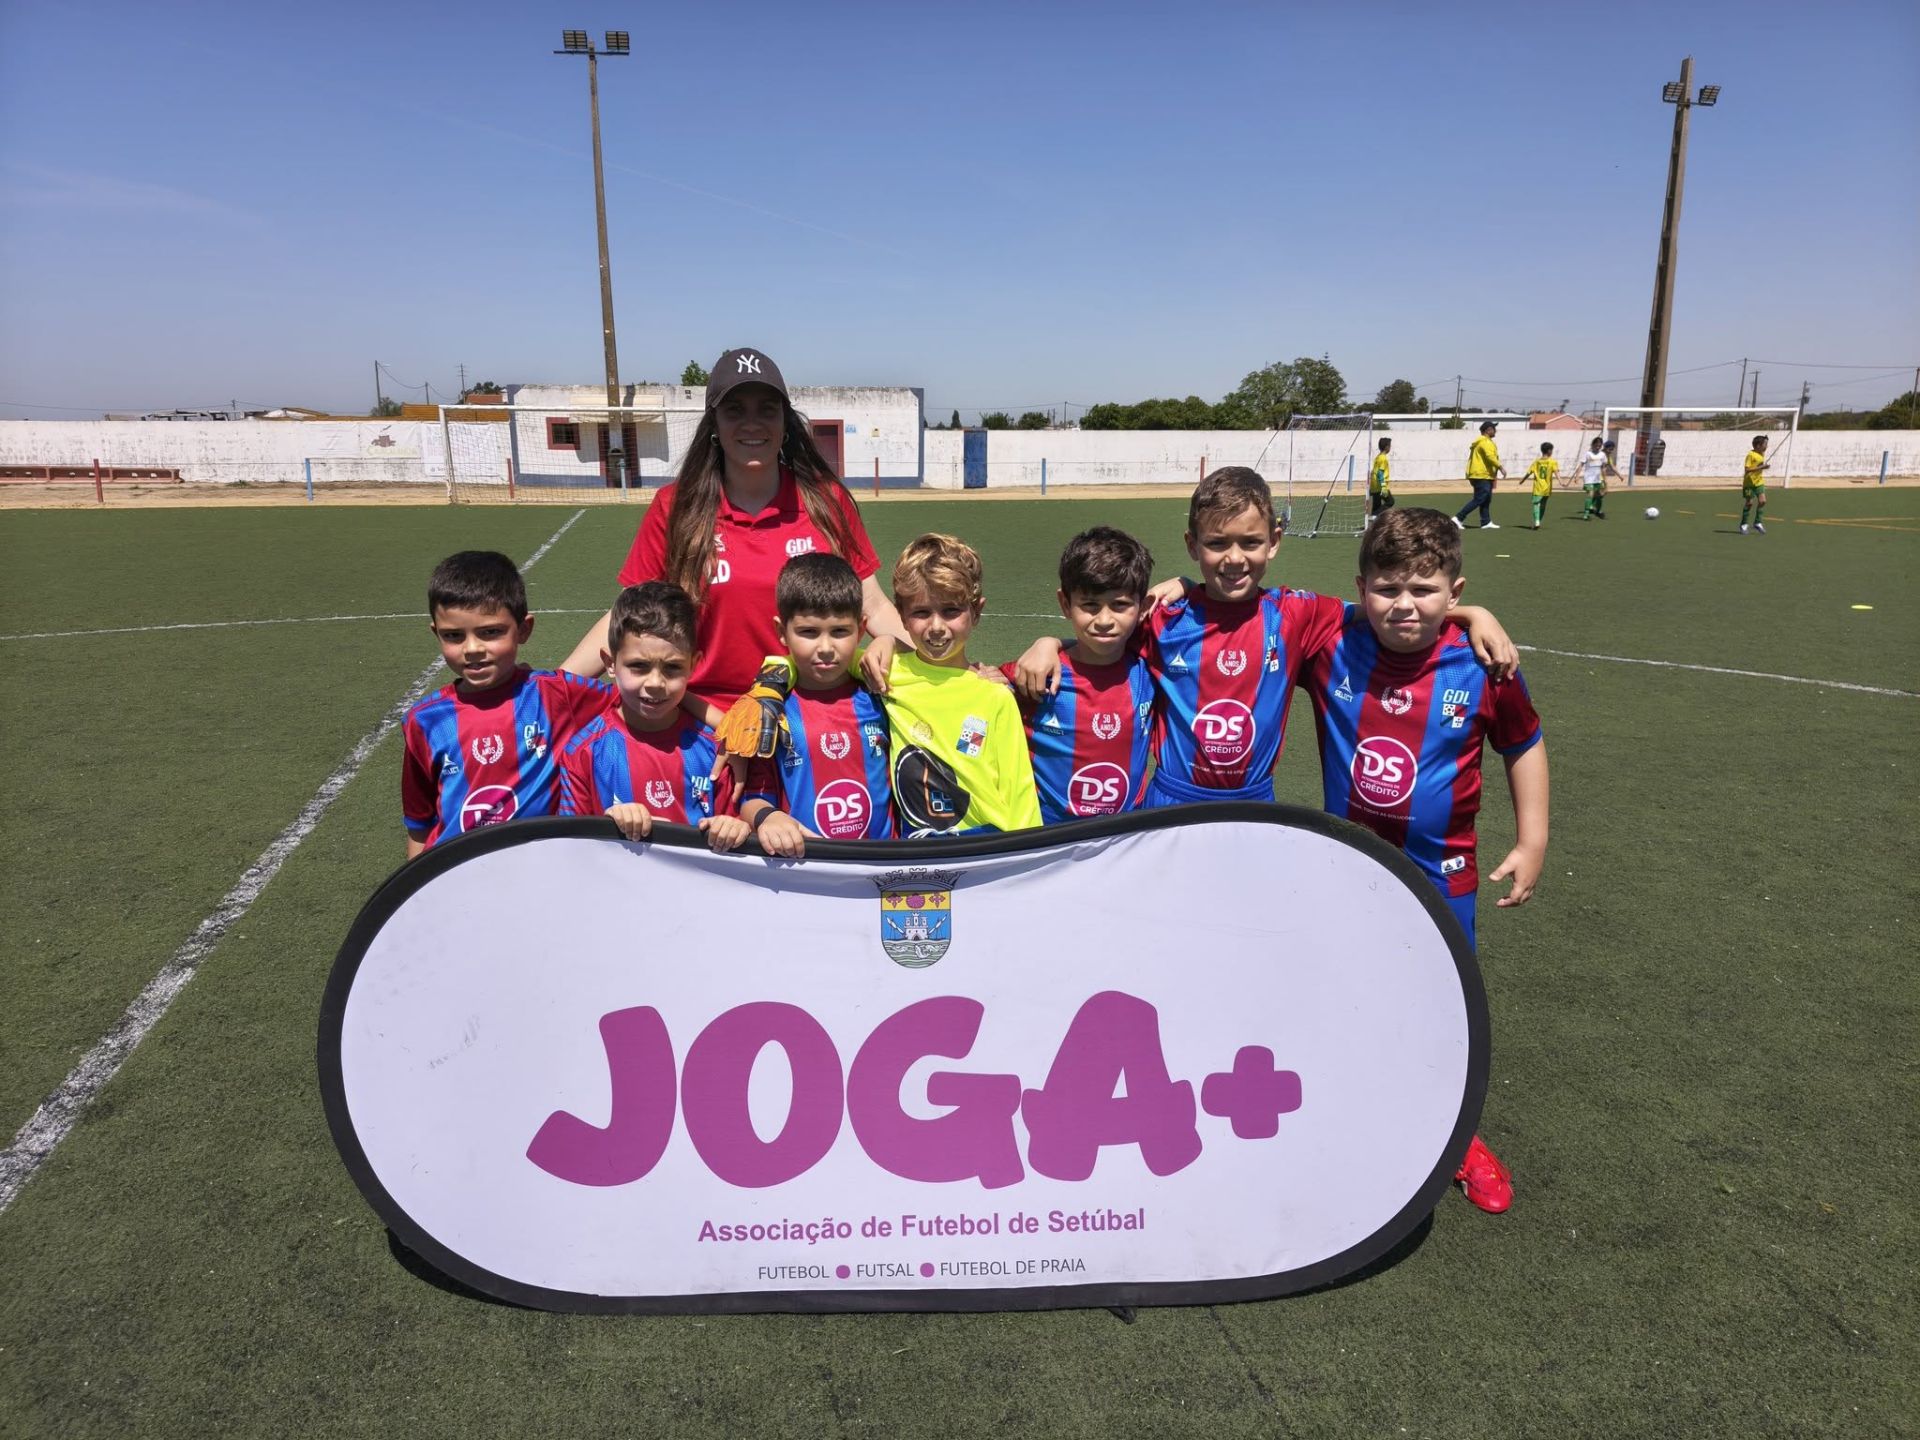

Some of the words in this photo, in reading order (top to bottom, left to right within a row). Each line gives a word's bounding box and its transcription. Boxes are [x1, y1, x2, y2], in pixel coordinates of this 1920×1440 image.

[736, 354, 761, 374] NY
[785, 536, 816, 554] GDL
[1334, 689, 1354, 702] SELECT
[1442, 689, 1470, 705] GDL
[1102, 714, 1111, 724] 50
[1200, 713, 1244, 741] DS
[1205, 745, 1243, 754] CRÉDITO
[1358, 746, 1405, 783] DS
[1074, 776, 1120, 803] DS
[1360, 780, 1399, 798] CRÉDITO
[816, 792, 864, 822] DS
[830, 822, 864, 835] CRÉDITO
[698, 1216, 853, 1245] Associação
[860, 1215, 893, 1238] de
[900, 1212, 1000, 1238] Futebol
[1008, 1211, 1039, 1235] de
[1047, 1208, 1146, 1233] Setúbal
[758, 1264, 830, 1281] FUTEBOL
[856, 1263, 915, 1278] FUTSAL
[940, 1261, 1012, 1277] FUTEBOL
[1015, 1260, 1037, 1276] DE
[1040, 1258, 1086, 1274] PRAIA
